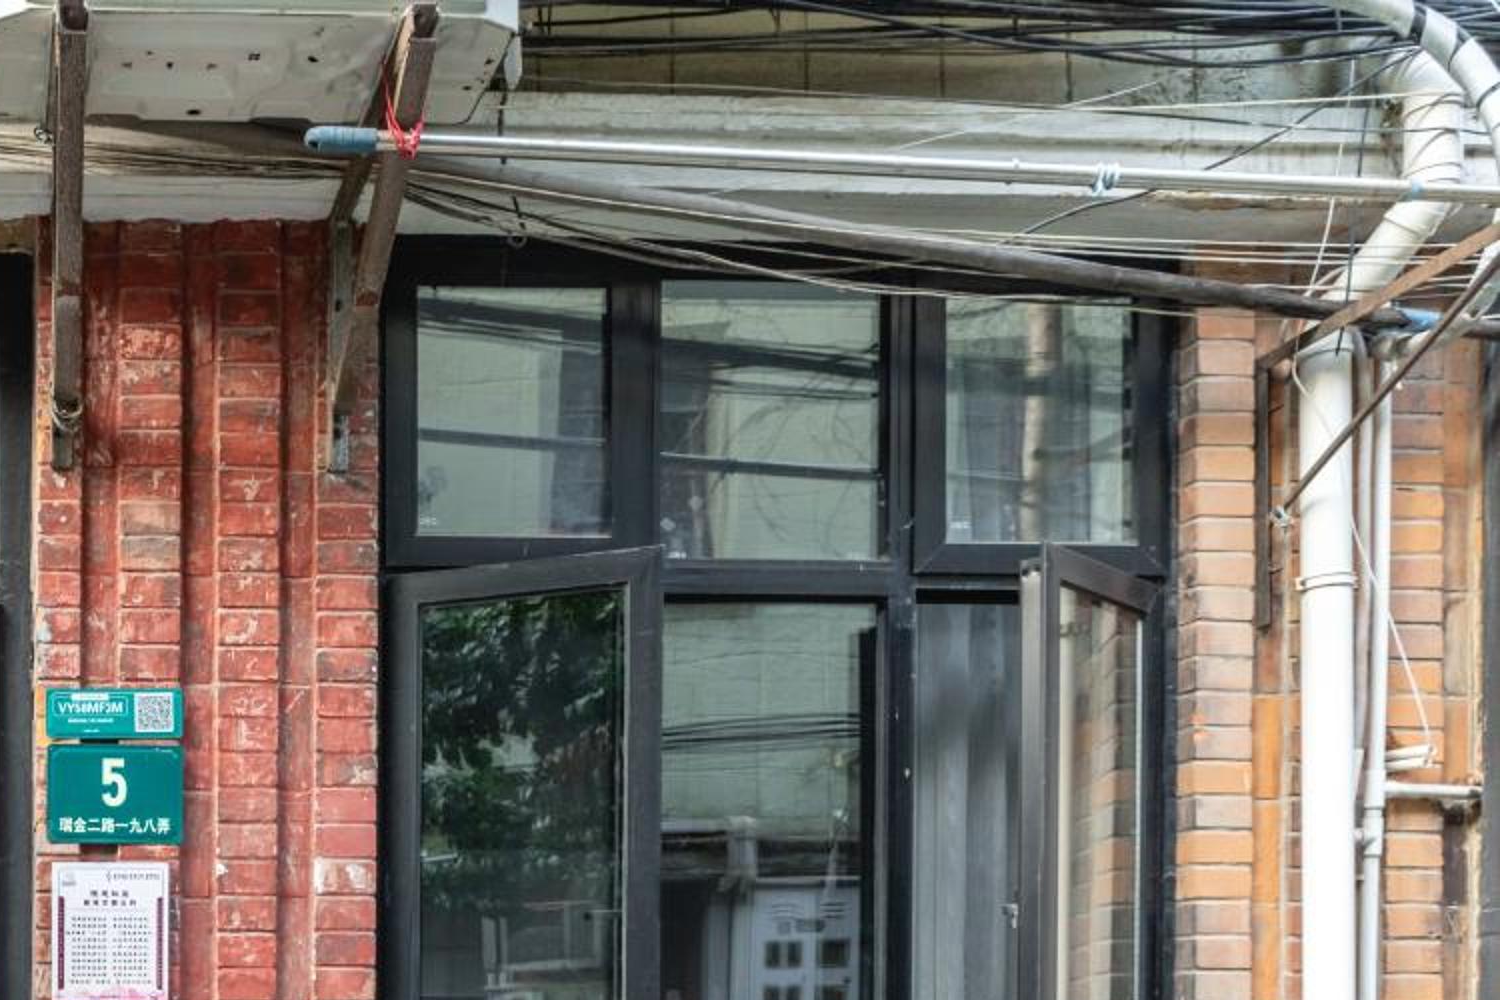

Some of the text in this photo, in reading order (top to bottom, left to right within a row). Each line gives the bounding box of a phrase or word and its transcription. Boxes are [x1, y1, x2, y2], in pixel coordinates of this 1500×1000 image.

[101, 757, 128, 807] 5
[58, 817, 171, 835] 瑞金二路一九八弄
